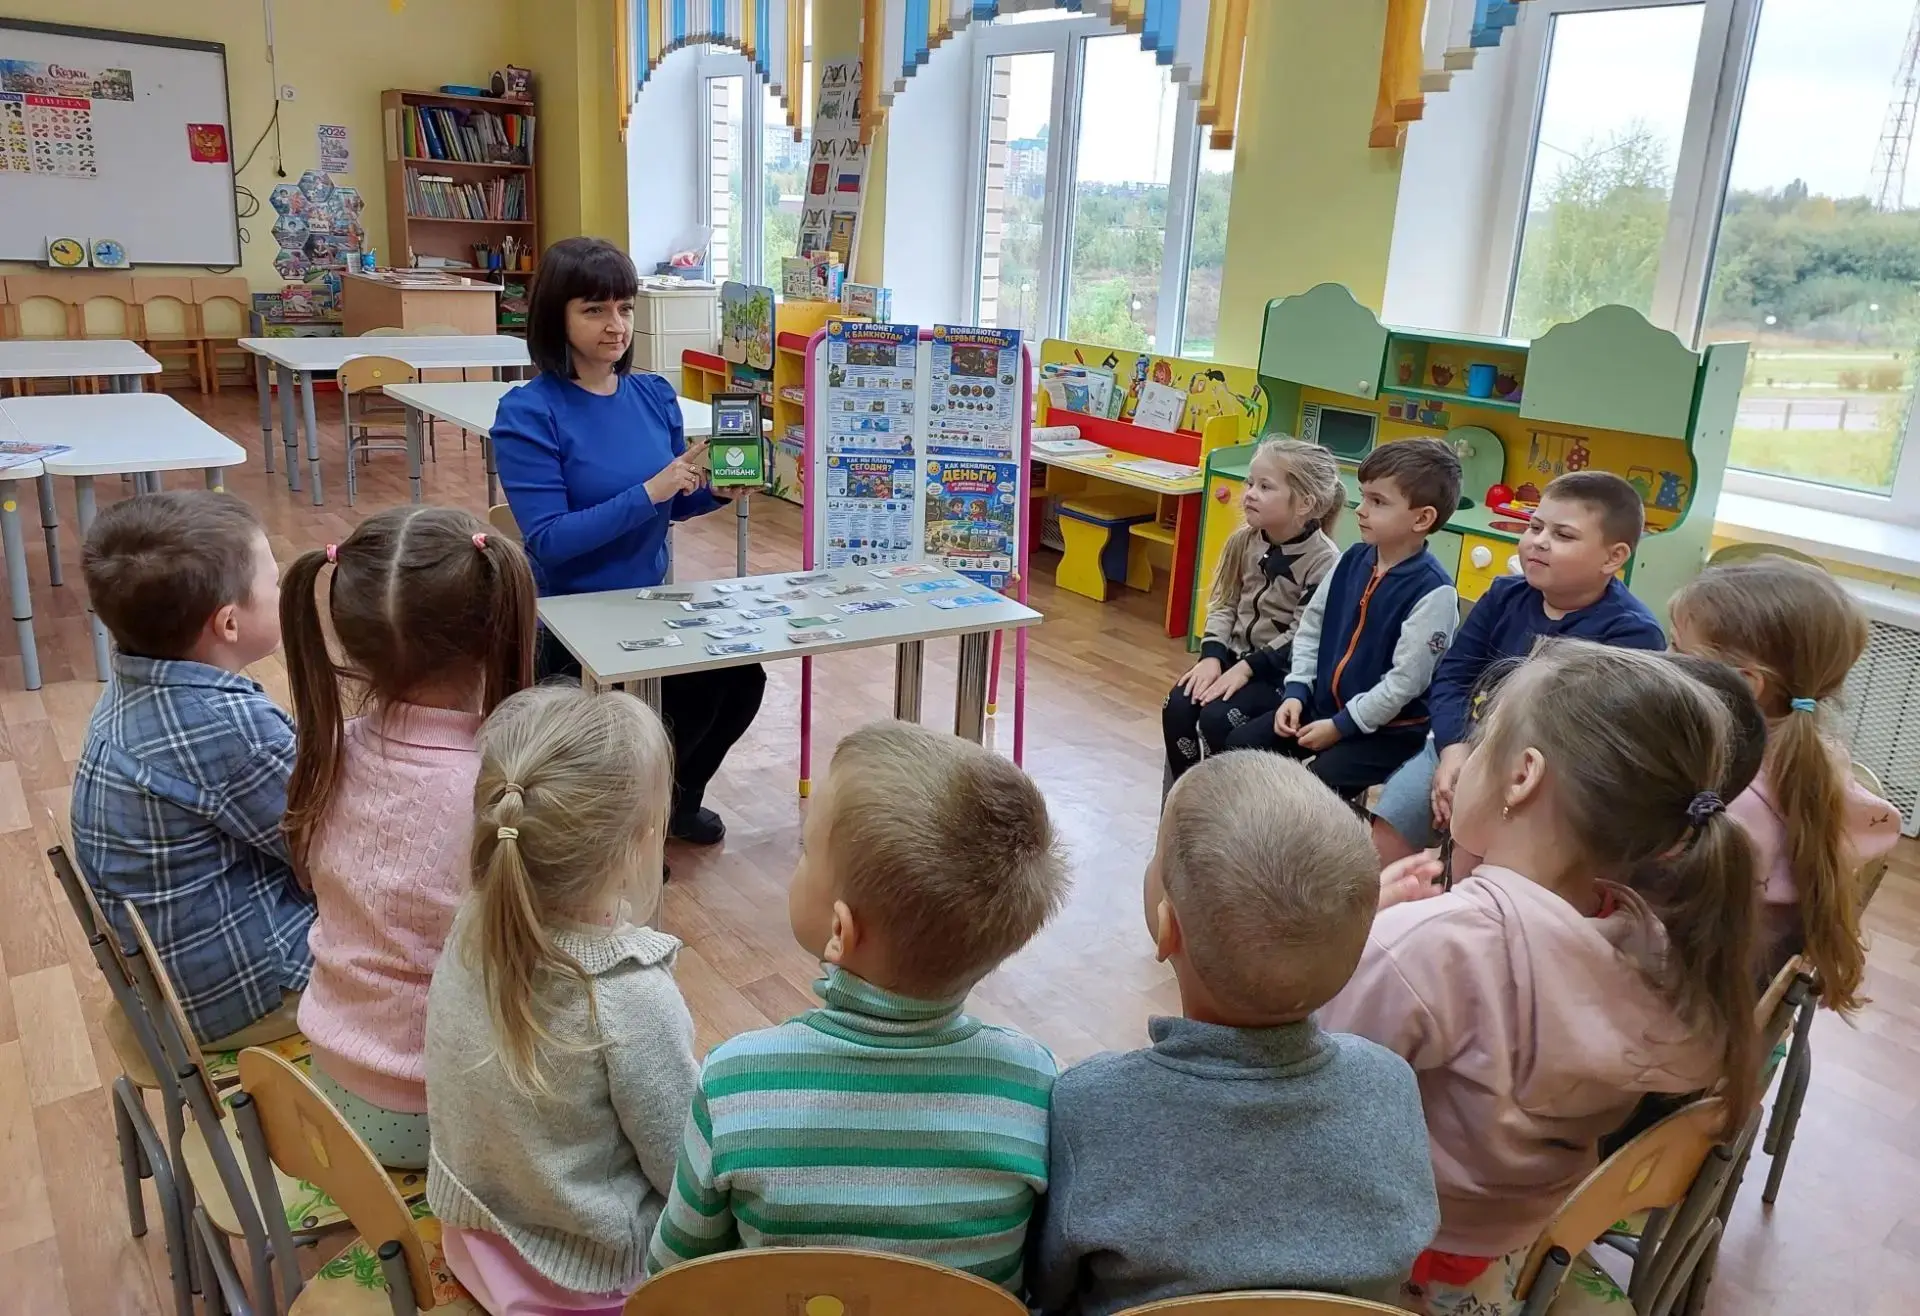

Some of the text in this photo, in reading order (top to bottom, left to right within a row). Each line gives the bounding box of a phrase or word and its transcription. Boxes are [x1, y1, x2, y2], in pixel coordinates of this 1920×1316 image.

[319, 126, 346, 137] 2026
[852, 323, 894, 332] ОТ МОНЕТ
[852, 331, 903, 341] БАНКНОТАМ
[950, 328, 1001, 337] ПОЯВЛЯЮТСЯ
[945, 335, 1009, 346] ПЕРВЫЕ МОНЕТЫ
[715, 468, 756, 476] КОПИБАНК
[850, 463, 892, 472] СЕГОДНЯ?
[942, 469, 997, 483] ДЕНЬГИ
